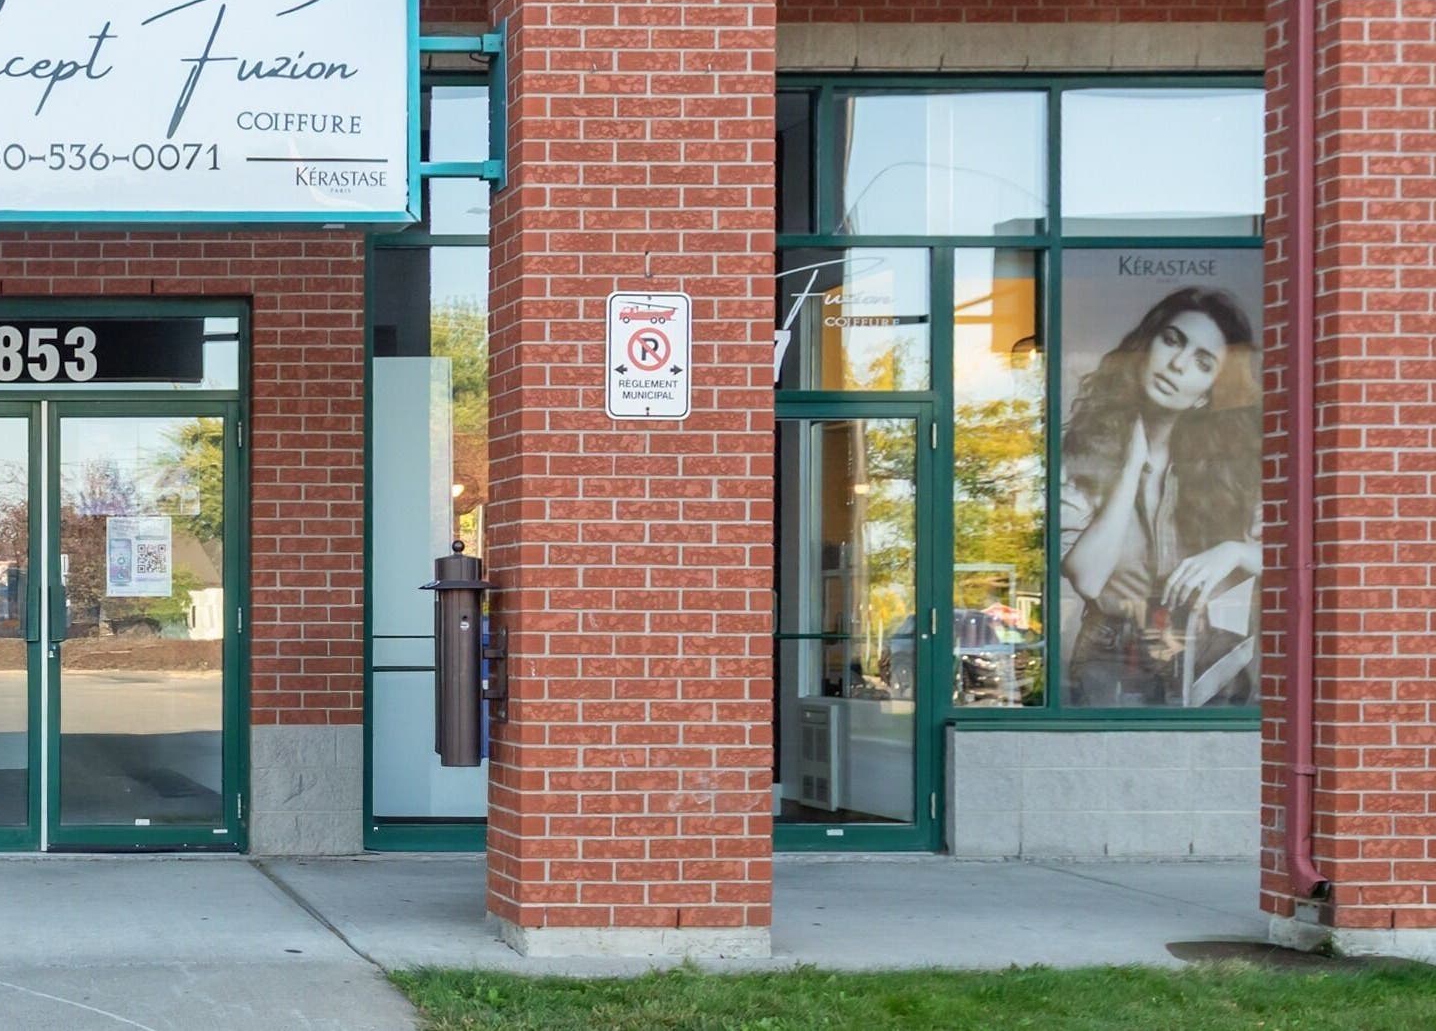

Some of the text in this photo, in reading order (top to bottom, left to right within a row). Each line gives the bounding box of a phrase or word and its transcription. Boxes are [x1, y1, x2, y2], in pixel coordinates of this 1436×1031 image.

[237, 111, 362, 135] COIFFURE
[296, 166, 387, 187] KÉRASTASE
[1118, 255, 1218, 276] KÉRASTASE
[622, 392, 674, 400] MUNICIPAL
